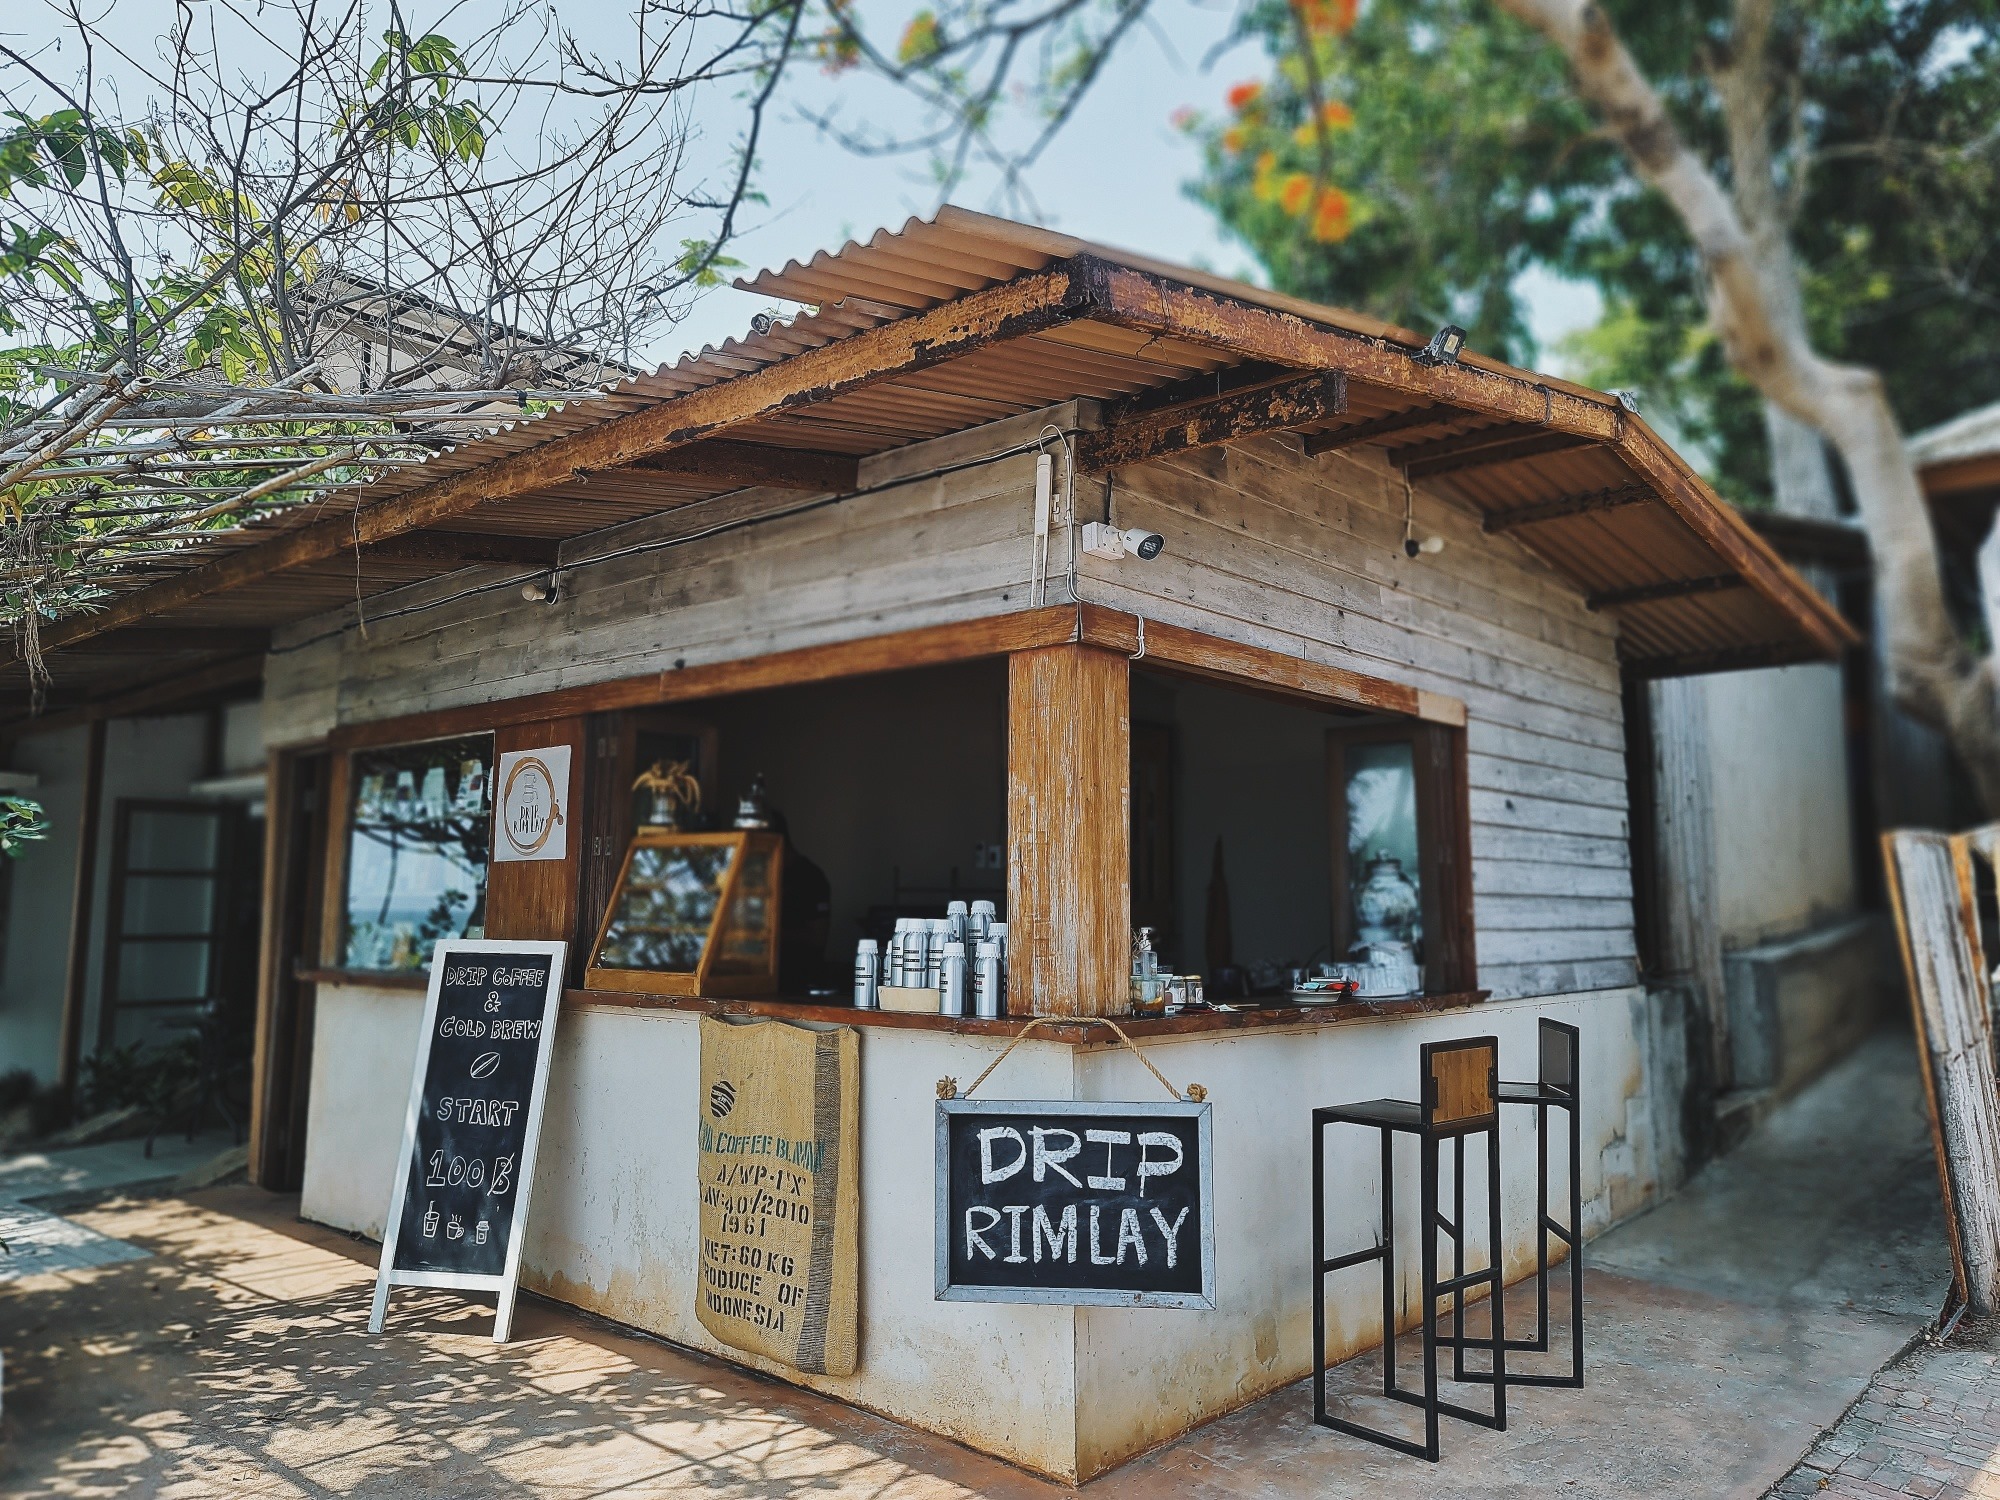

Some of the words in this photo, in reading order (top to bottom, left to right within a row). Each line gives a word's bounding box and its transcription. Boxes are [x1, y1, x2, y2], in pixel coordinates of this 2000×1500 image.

[520, 805, 539, 820] DRIP
[513, 817, 545, 834] RIMLAY
[446, 967, 488, 987] DRIP
[483, 990, 502, 1013] &
[440, 1016, 487, 1038] COLD
[490, 1019, 543, 1040] BREW
[436, 1096, 519, 1127] START
[715, 1131, 773, 1155] COFFEE
[976, 1125, 1184, 1198] DRIP
[965, 1203, 1190, 1269] RIMLAY
[766, 1251, 795, 1277] KG
[703, 1253, 762, 1297] RODUCE
[777, 1282, 805, 1307] OF
[705, 1286, 784, 1333] INDONESIA
